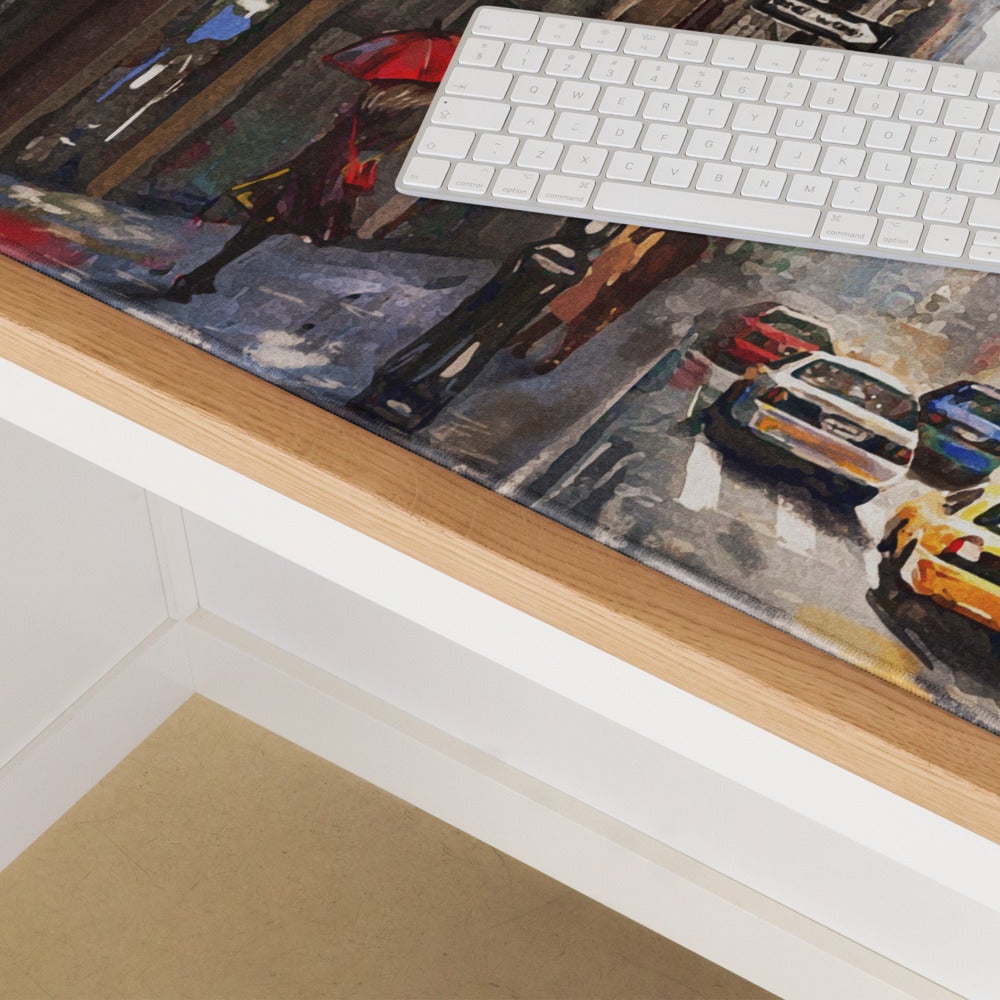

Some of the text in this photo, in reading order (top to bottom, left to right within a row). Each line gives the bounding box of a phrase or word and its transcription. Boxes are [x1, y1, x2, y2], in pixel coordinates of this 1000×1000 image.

[562, 63, 572, 72] 2
[605, 68, 615, 78] 3
[649, 75, 658, 83] 4
[693, 80, 702, 89] 5
[528, 85, 539, 94] Q
[737, 86, 747, 94] 6
[572, 91, 585, 100] W
[783, 91, 792, 100] 7
[617, 96, 627, 105] E
[826, 96, 836, 105] 8
[660, 102, 671, 111] R
[871, 102, 880, 111] 9
[706, 107, 716, 117] T
[915, 108, 925, 117] 0
[751, 113, 759, 122] Y
[525, 118, 536, 127] A
[794, 119, 805, 128] U
[615, 128, 625, 137] D
[883, 130, 894, 140] O
[659, 134, 669, 142] F
[928, 136, 938, 145] P
[704, 139, 714, 149] G
[748, 145, 759, 154] H
[535, 150, 545, 160] Z
[580, 155, 589, 164] X
[794, 151, 803, 160] J
[839, 156, 848, 165] K
[624, 161, 635, 171] C
[884, 162, 891, 172] L
[671, 167, 680, 177] V
[714, 173, 724, 182] B
[455, 180, 484, 189] control
[759, 179, 770, 188] N
[501, 186, 528, 195] option
[803, 184, 816, 193] M
[545, 192, 584, 202] command
[825, 230, 866, 240] command
[883, 237, 910, 246] option
